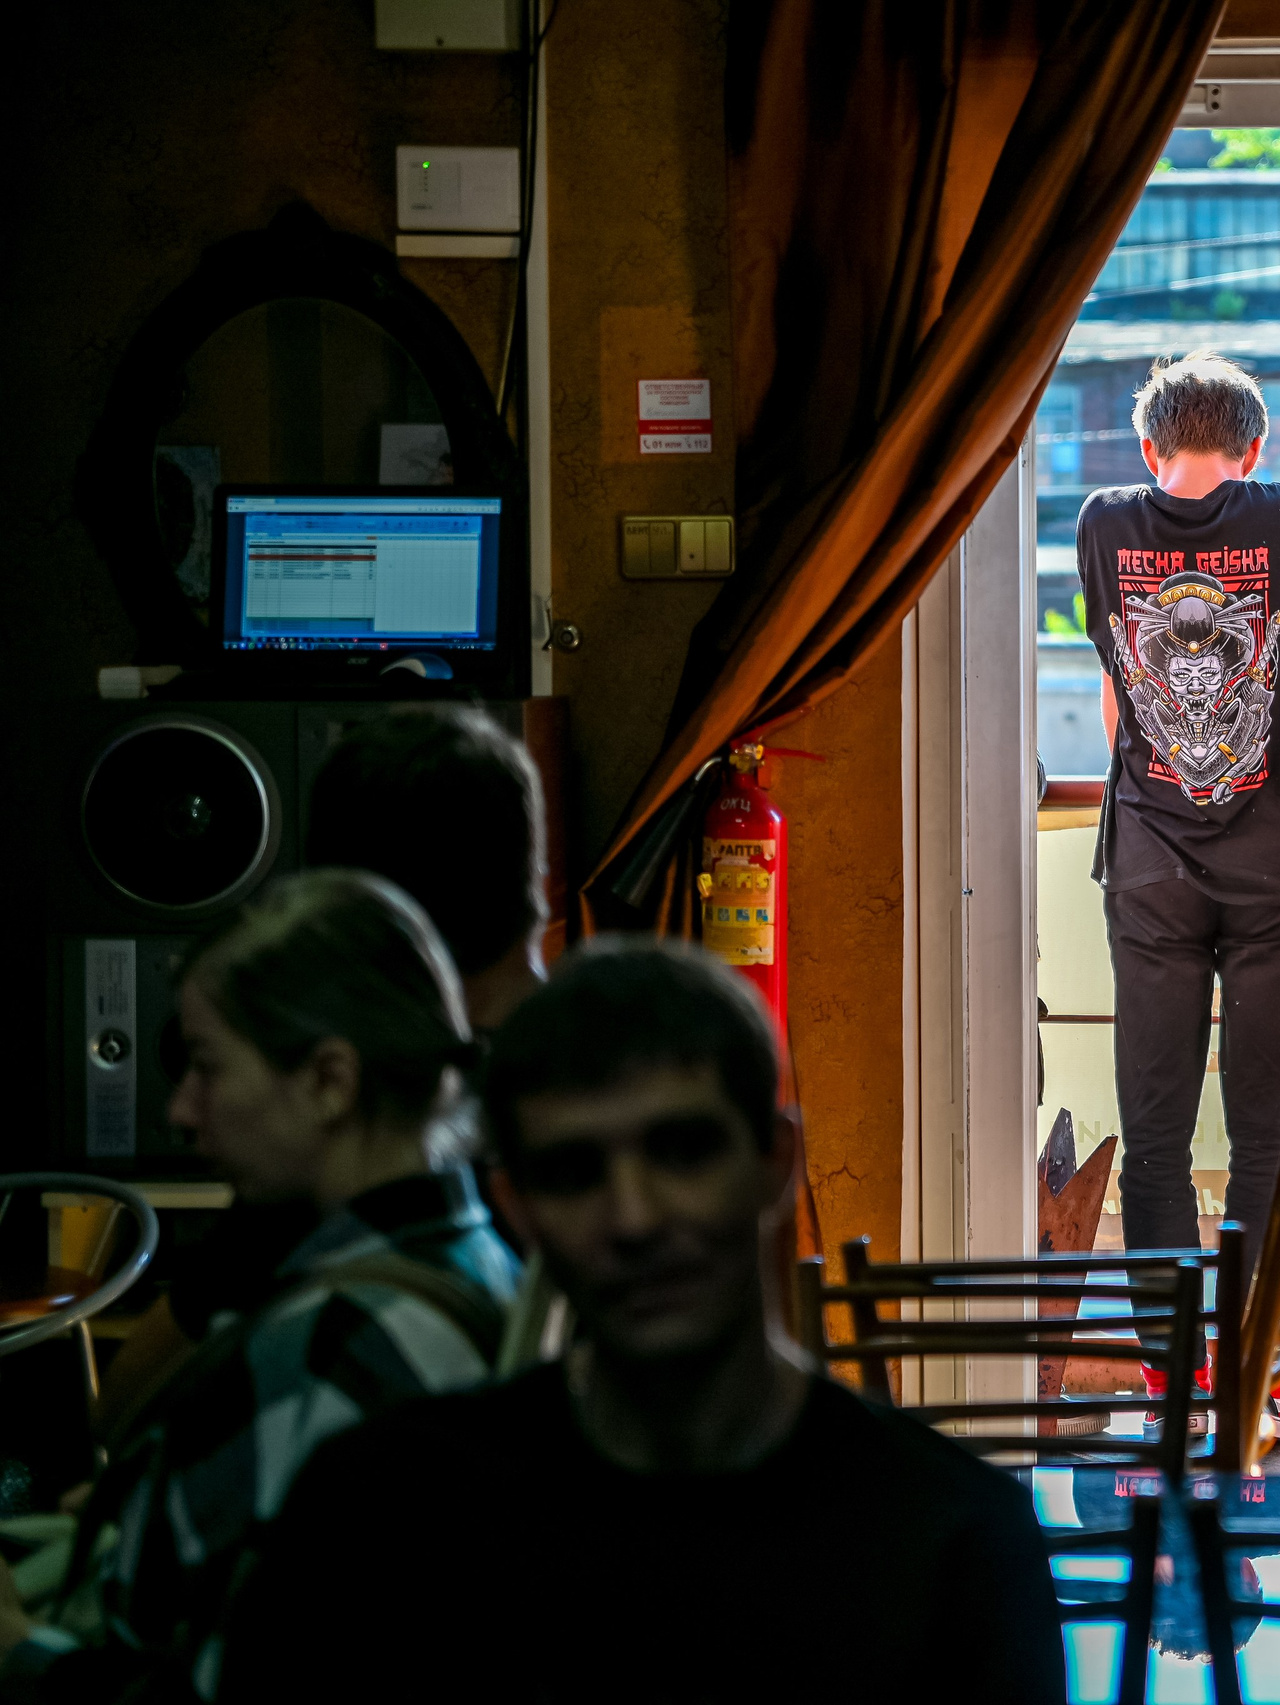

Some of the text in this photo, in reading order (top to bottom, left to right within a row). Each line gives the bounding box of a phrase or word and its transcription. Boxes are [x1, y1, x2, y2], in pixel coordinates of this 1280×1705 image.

[652, 440, 662, 449] 01
[694, 440, 708, 449] 112
[1117, 548, 1185, 575] MECHA
